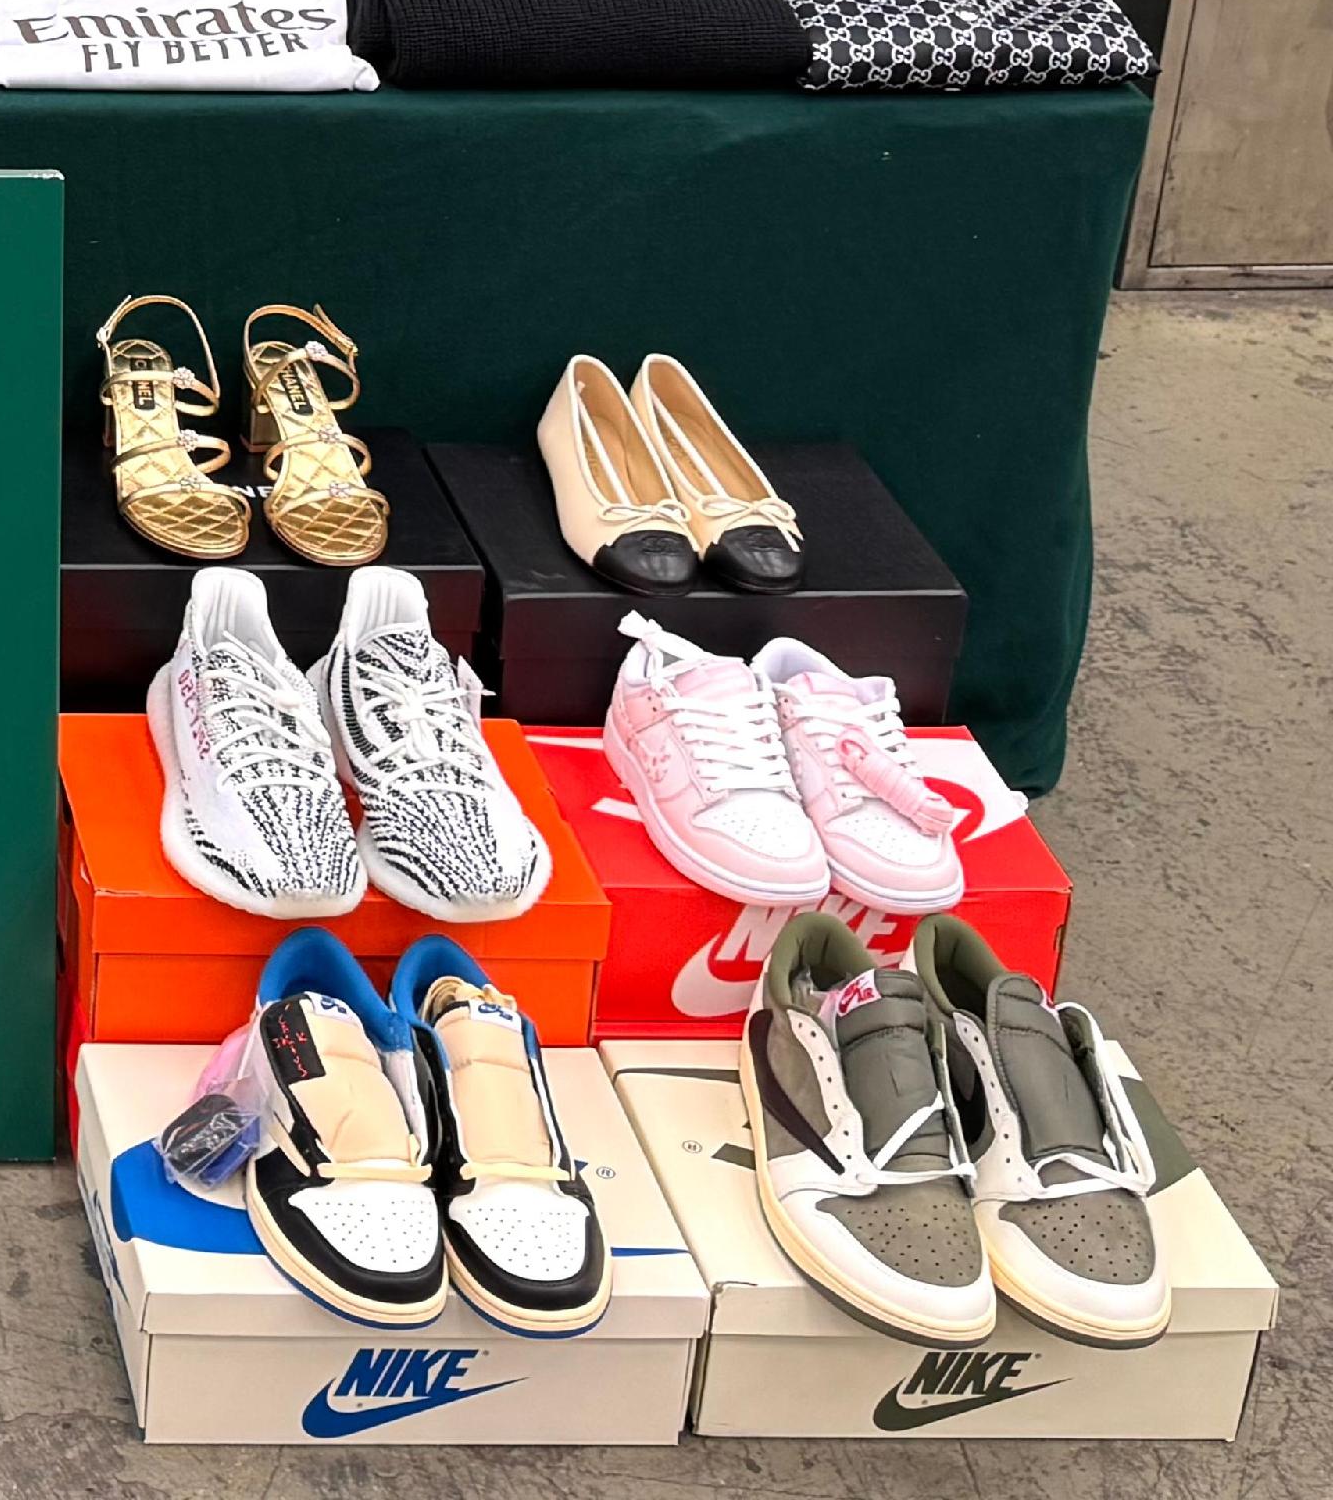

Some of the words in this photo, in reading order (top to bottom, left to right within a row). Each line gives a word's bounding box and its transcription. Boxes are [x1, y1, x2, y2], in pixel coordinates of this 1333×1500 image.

[13, 0, 337, 44] Emirates
[82, 41, 141, 73] FLY
[163, 32, 309, 66] BETTER
[134, 359, 151, 406] CNEL
[281, 363, 305, 411] HANEL
[334, 1348, 480, 1398] NIKE
[902, 1352, 1033, 1396] NIKE
